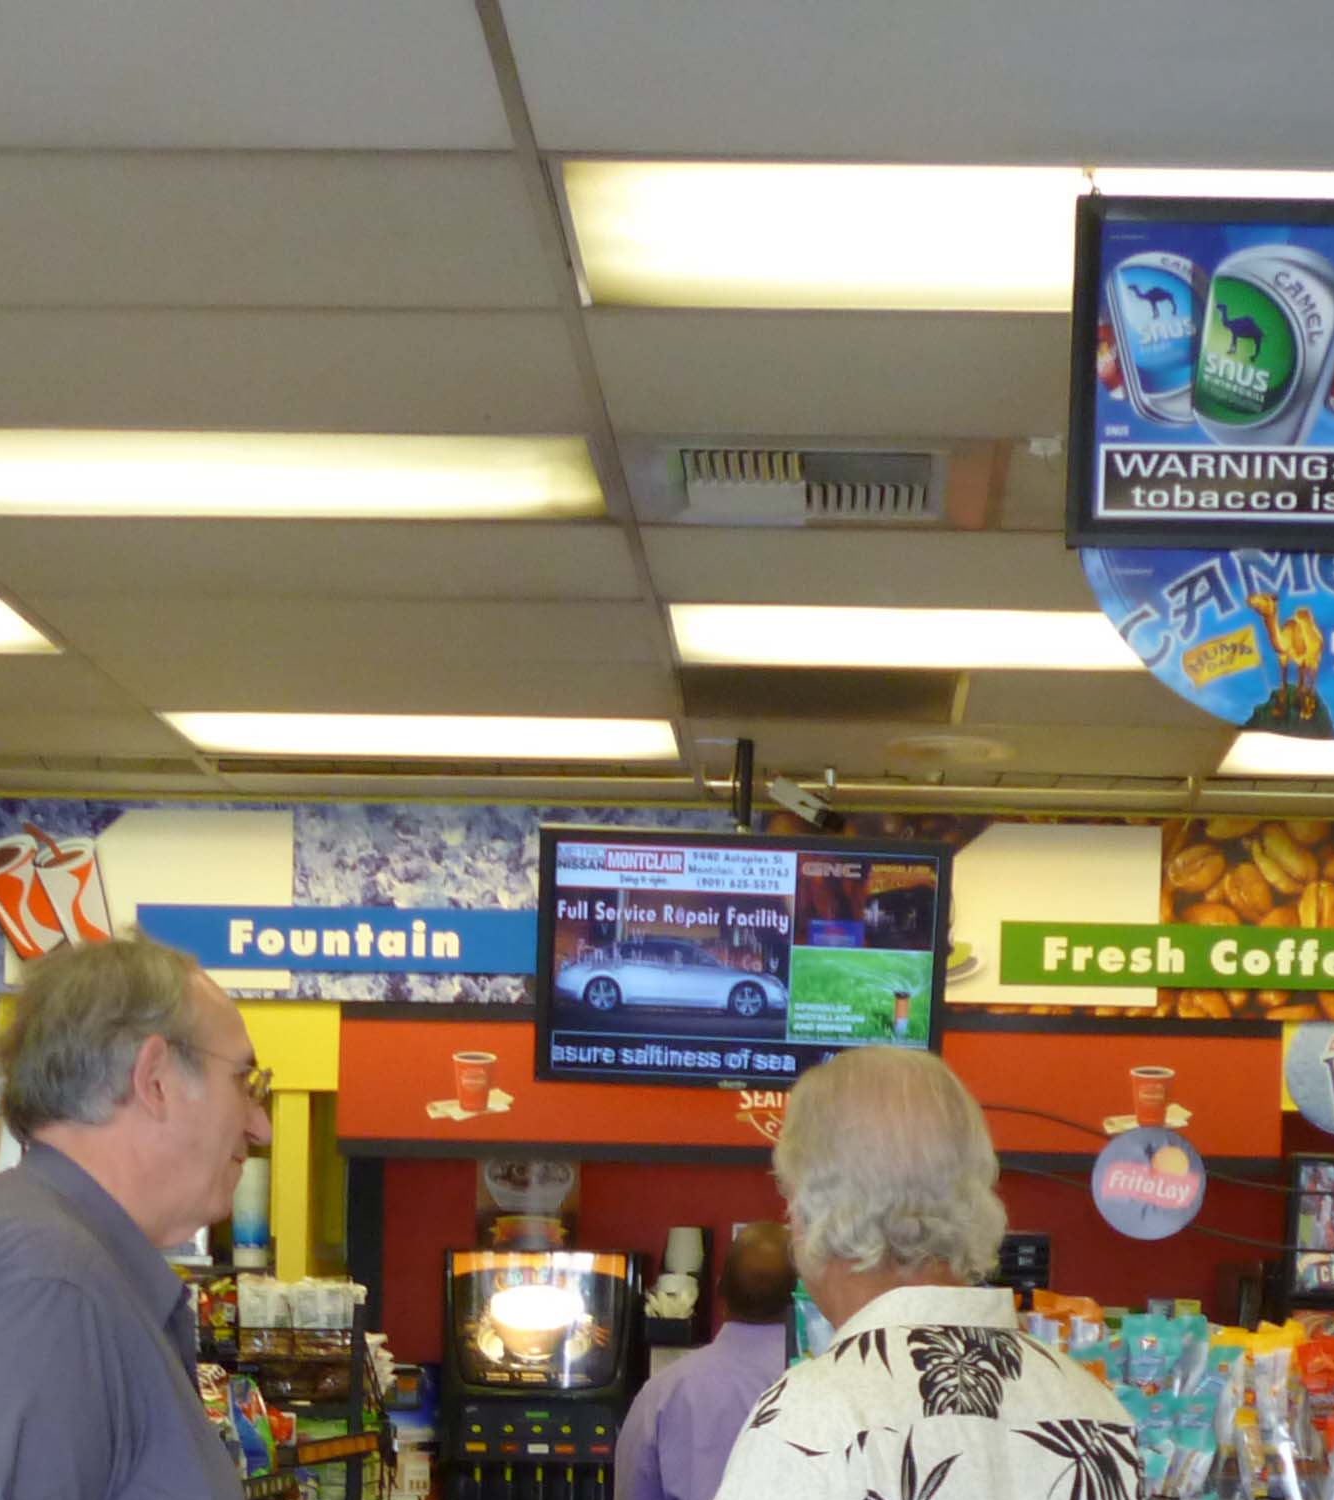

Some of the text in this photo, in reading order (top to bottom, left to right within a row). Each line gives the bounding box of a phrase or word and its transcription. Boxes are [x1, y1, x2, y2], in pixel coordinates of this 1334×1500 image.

[1273, 271, 1324, 347] CAMEL
[1131, 484, 1299, 512] tobacco
[557, 899, 790, 935] Full Service Repair Facility
[229, 918, 463, 959] Fountain
[1043, 936, 1187, 976] Fresh
[752, 1052, 796, 1073] sea
